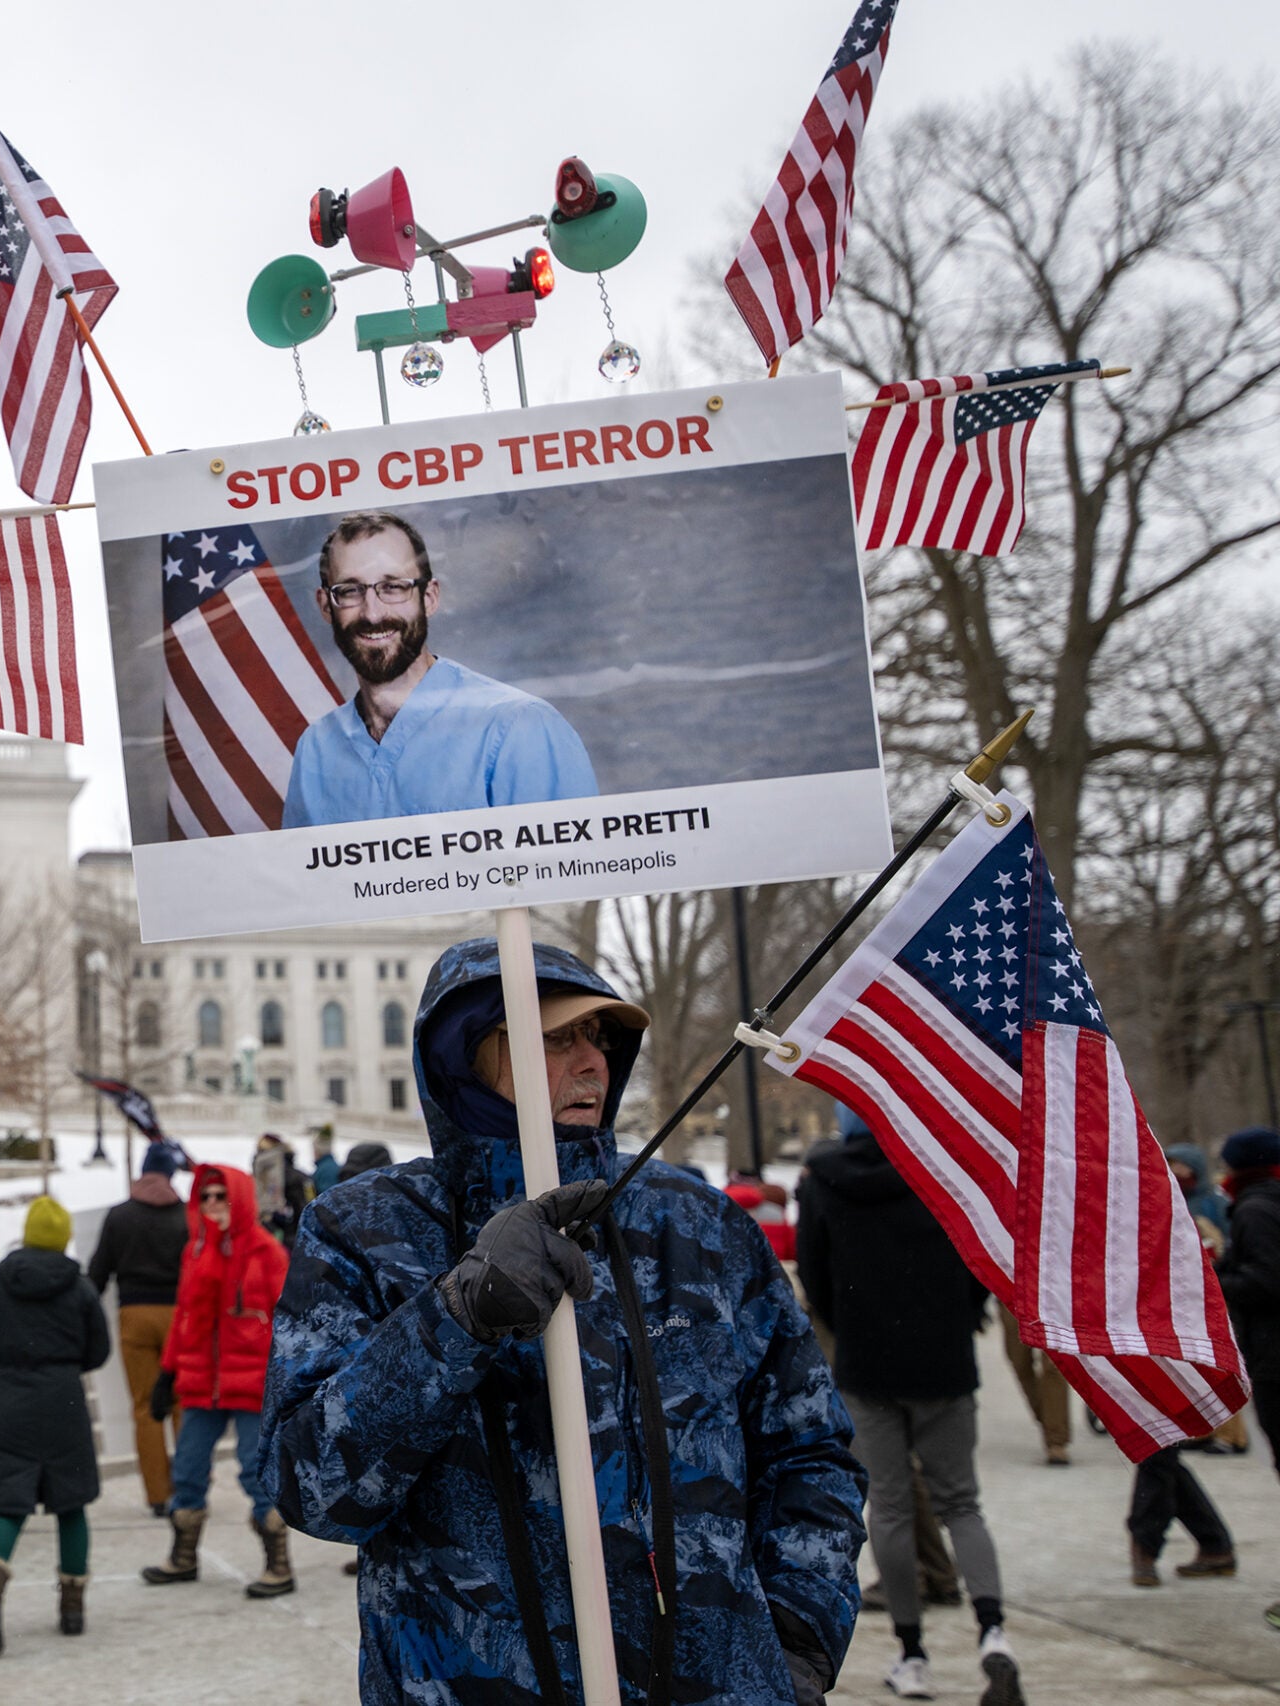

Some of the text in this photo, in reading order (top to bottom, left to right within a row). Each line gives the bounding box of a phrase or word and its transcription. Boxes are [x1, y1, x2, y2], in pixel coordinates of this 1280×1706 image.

[226, 415, 713, 510] STOP CBP TERROR
[305, 806, 710, 870] JUSTICE FOR ALEX PRETTI
[353, 872, 450, 900] Murdered
[455, 870, 480, 891] by
[535, 863, 553, 880] in
[558, 850, 677, 879] Minneapolis
[645, 1314, 690, 1337] Colmbia
